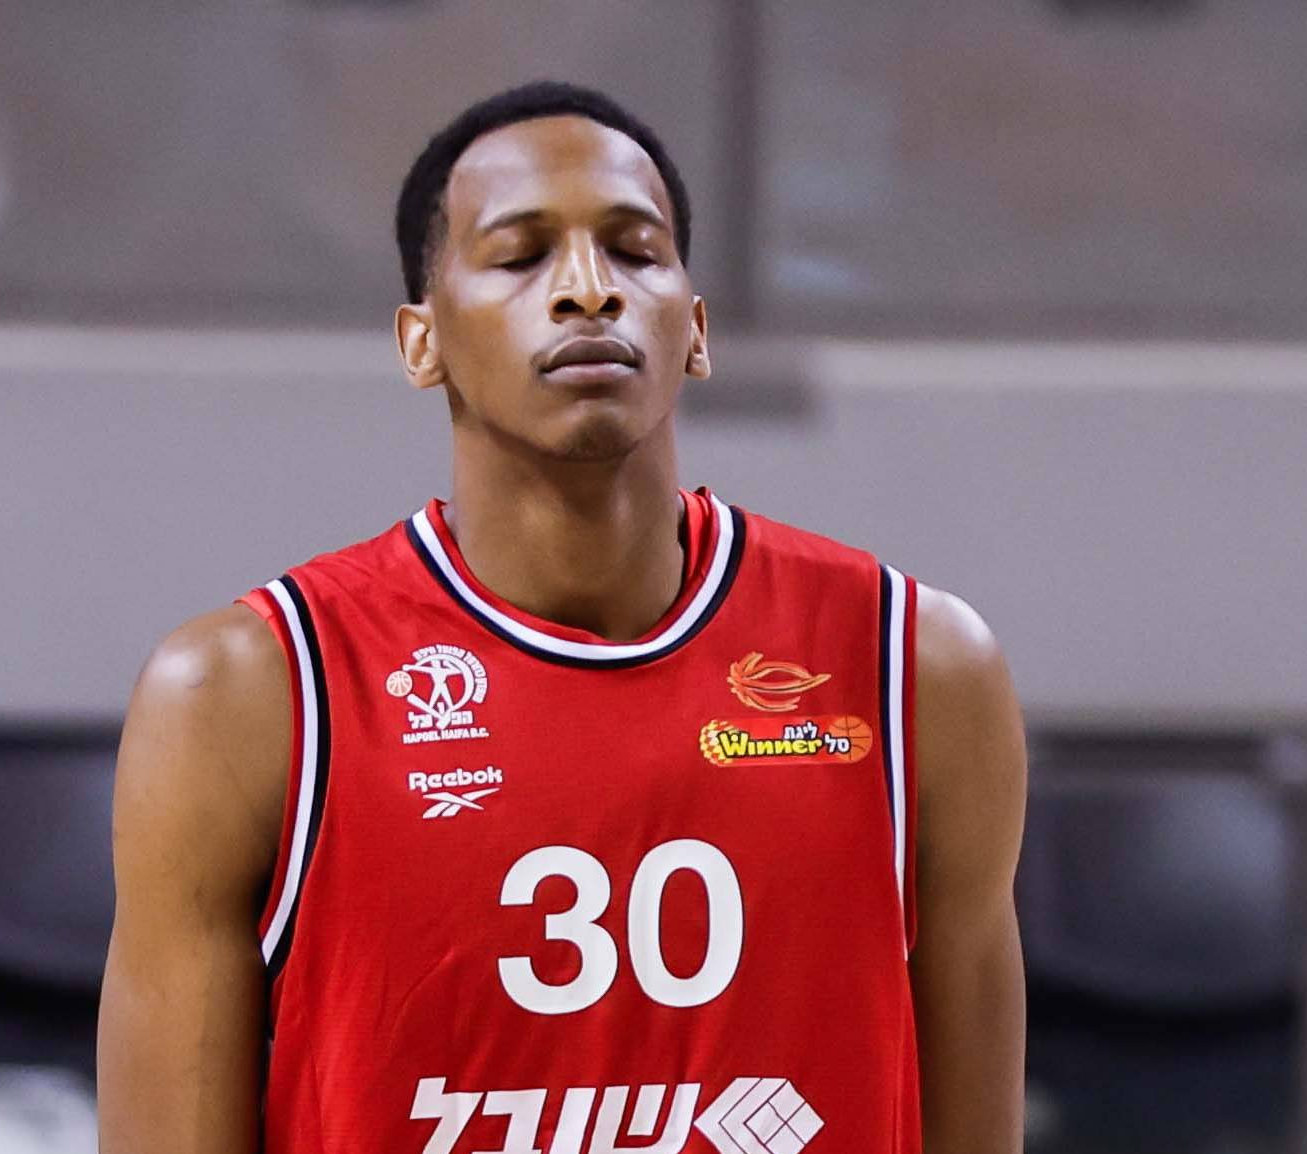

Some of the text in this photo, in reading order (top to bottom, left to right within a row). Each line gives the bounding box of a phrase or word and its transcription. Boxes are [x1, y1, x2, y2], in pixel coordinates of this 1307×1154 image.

[784, 721, 818, 740] ליגת
[824, 733, 850, 753] סל
[408, 767, 503, 792] Reebok
[498, 838, 744, 1015] 30
